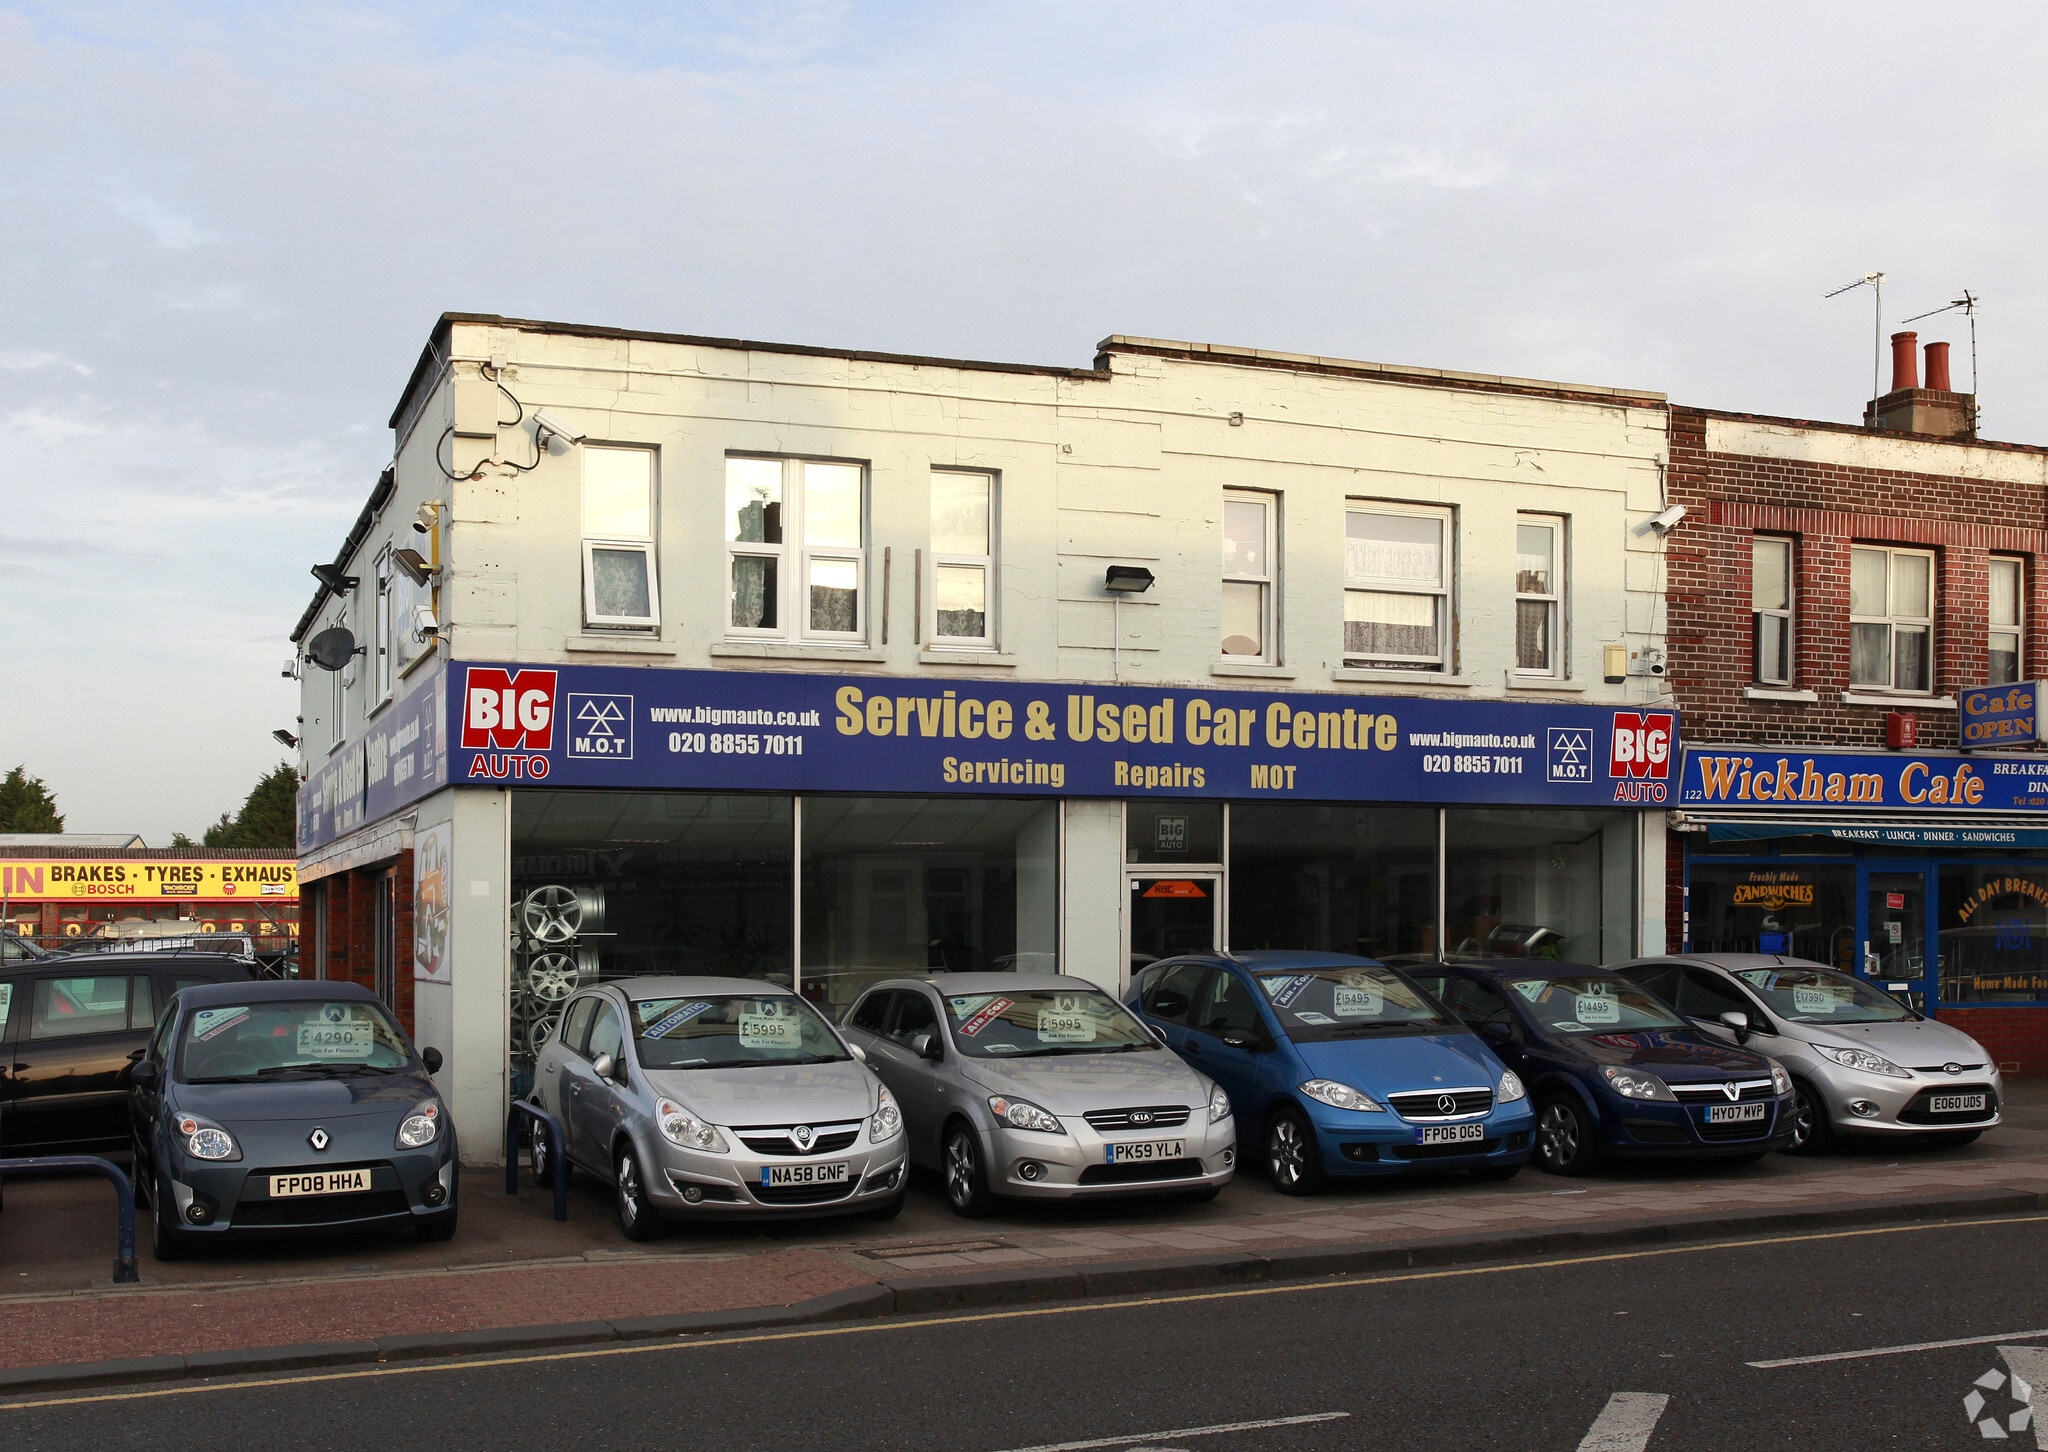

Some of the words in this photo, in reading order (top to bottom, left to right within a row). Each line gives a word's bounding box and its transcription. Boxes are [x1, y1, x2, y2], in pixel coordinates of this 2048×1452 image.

[470, 688, 550, 731] BIG
[1965, 689, 2033, 715] Cafe
[650, 706, 820, 727] www.bigmauto.co.uk
[835, 686, 1013, 740] Service
[1024, 700, 1056, 741] &
[1067, 695, 1174, 744] Used
[1185, 699, 1256, 746] Car
[1266, 702, 1398, 751] Centre
[1964, 718, 2034, 740] OPEN
[575, 738, 625, 753] M.O.T
[669, 732, 705, 753] 020
[710, 733, 759, 754] 8855
[764, 734, 802, 755] 7011
[1409, 732, 1536, 749] www.bigmauto.co.uk
[1614, 728, 1668, 763] BIG
[468, 753, 550, 779] AUTO
[943, 756, 1064, 788] Servicing
[1114, 761, 1205, 789] Repairs
[1251, 765, 1296, 789] MOT
[1423, 754, 1451, 773] 020
[1454, 755, 1491, 774] 8855
[1493, 756, 1523, 774] 7011
[1552, 765, 1587, 778] M.O.T
[1699, 756, 1884, 803] Wickham
[1899, 761, 1985, 805] Cafe
[1613, 782, 1667, 802] AUTO
[1684, 789, 1702, 800] 122
[2013, 796, 2026, 805] Tel
[1160, 824, 1183, 835] BIG
[1832, 829, 1879, 839] BREAKFAST
[1886, 830, 1915, 840] LUNCH
[1923, 832, 1954, 841] DINNER
[1962, 832, 2015, 842] SANDWICHES
[1160, 841, 1183, 849] AUTO
[51, 865, 126, 881] BRAKES
[144, 866, 203, 882] TYRES
[222, 866, 297, 882] EXHAUS
[1749, 872, 1777, 884] Freshly
[1779, 872, 1799, 881] Made
[87, 884, 134, 895] BOSCH
[1733, 885, 1814, 903] SANDWICHES
[1958, 897, 1979, 922] ALL
[1977, 879, 2000, 901] DAY
[1973, 976, 2000, 989] Home
[2003, 976, 2028, 989] Made
[1335, 992, 1370, 1005] £5495
[650, 1001, 705, 1037] AUTOMATIC
[967, 999, 1007, 1033] AIR-CON
[741, 1022, 785, 1036] £5995
[1934, 1097, 1961, 1110] EO60
[1963, 1096, 1982, 1107] UDS
[1712, 1107, 1741, 1120] HY07
[1744, 1104, 1763, 1118] MVP
[1424, 1127, 1457, 1141] FP06
[1459, 1125, 1482, 1139] OGS
[1115, 1144, 1152, 1159] PK59
[1156, 1142, 1182, 1157] YLA
[772, 1167, 813, 1183] NA58
[817, 1164, 845, 1180] GNF
[277, 1176, 324, 1193] FP08
[330, 1172, 363, 1190] HHA
